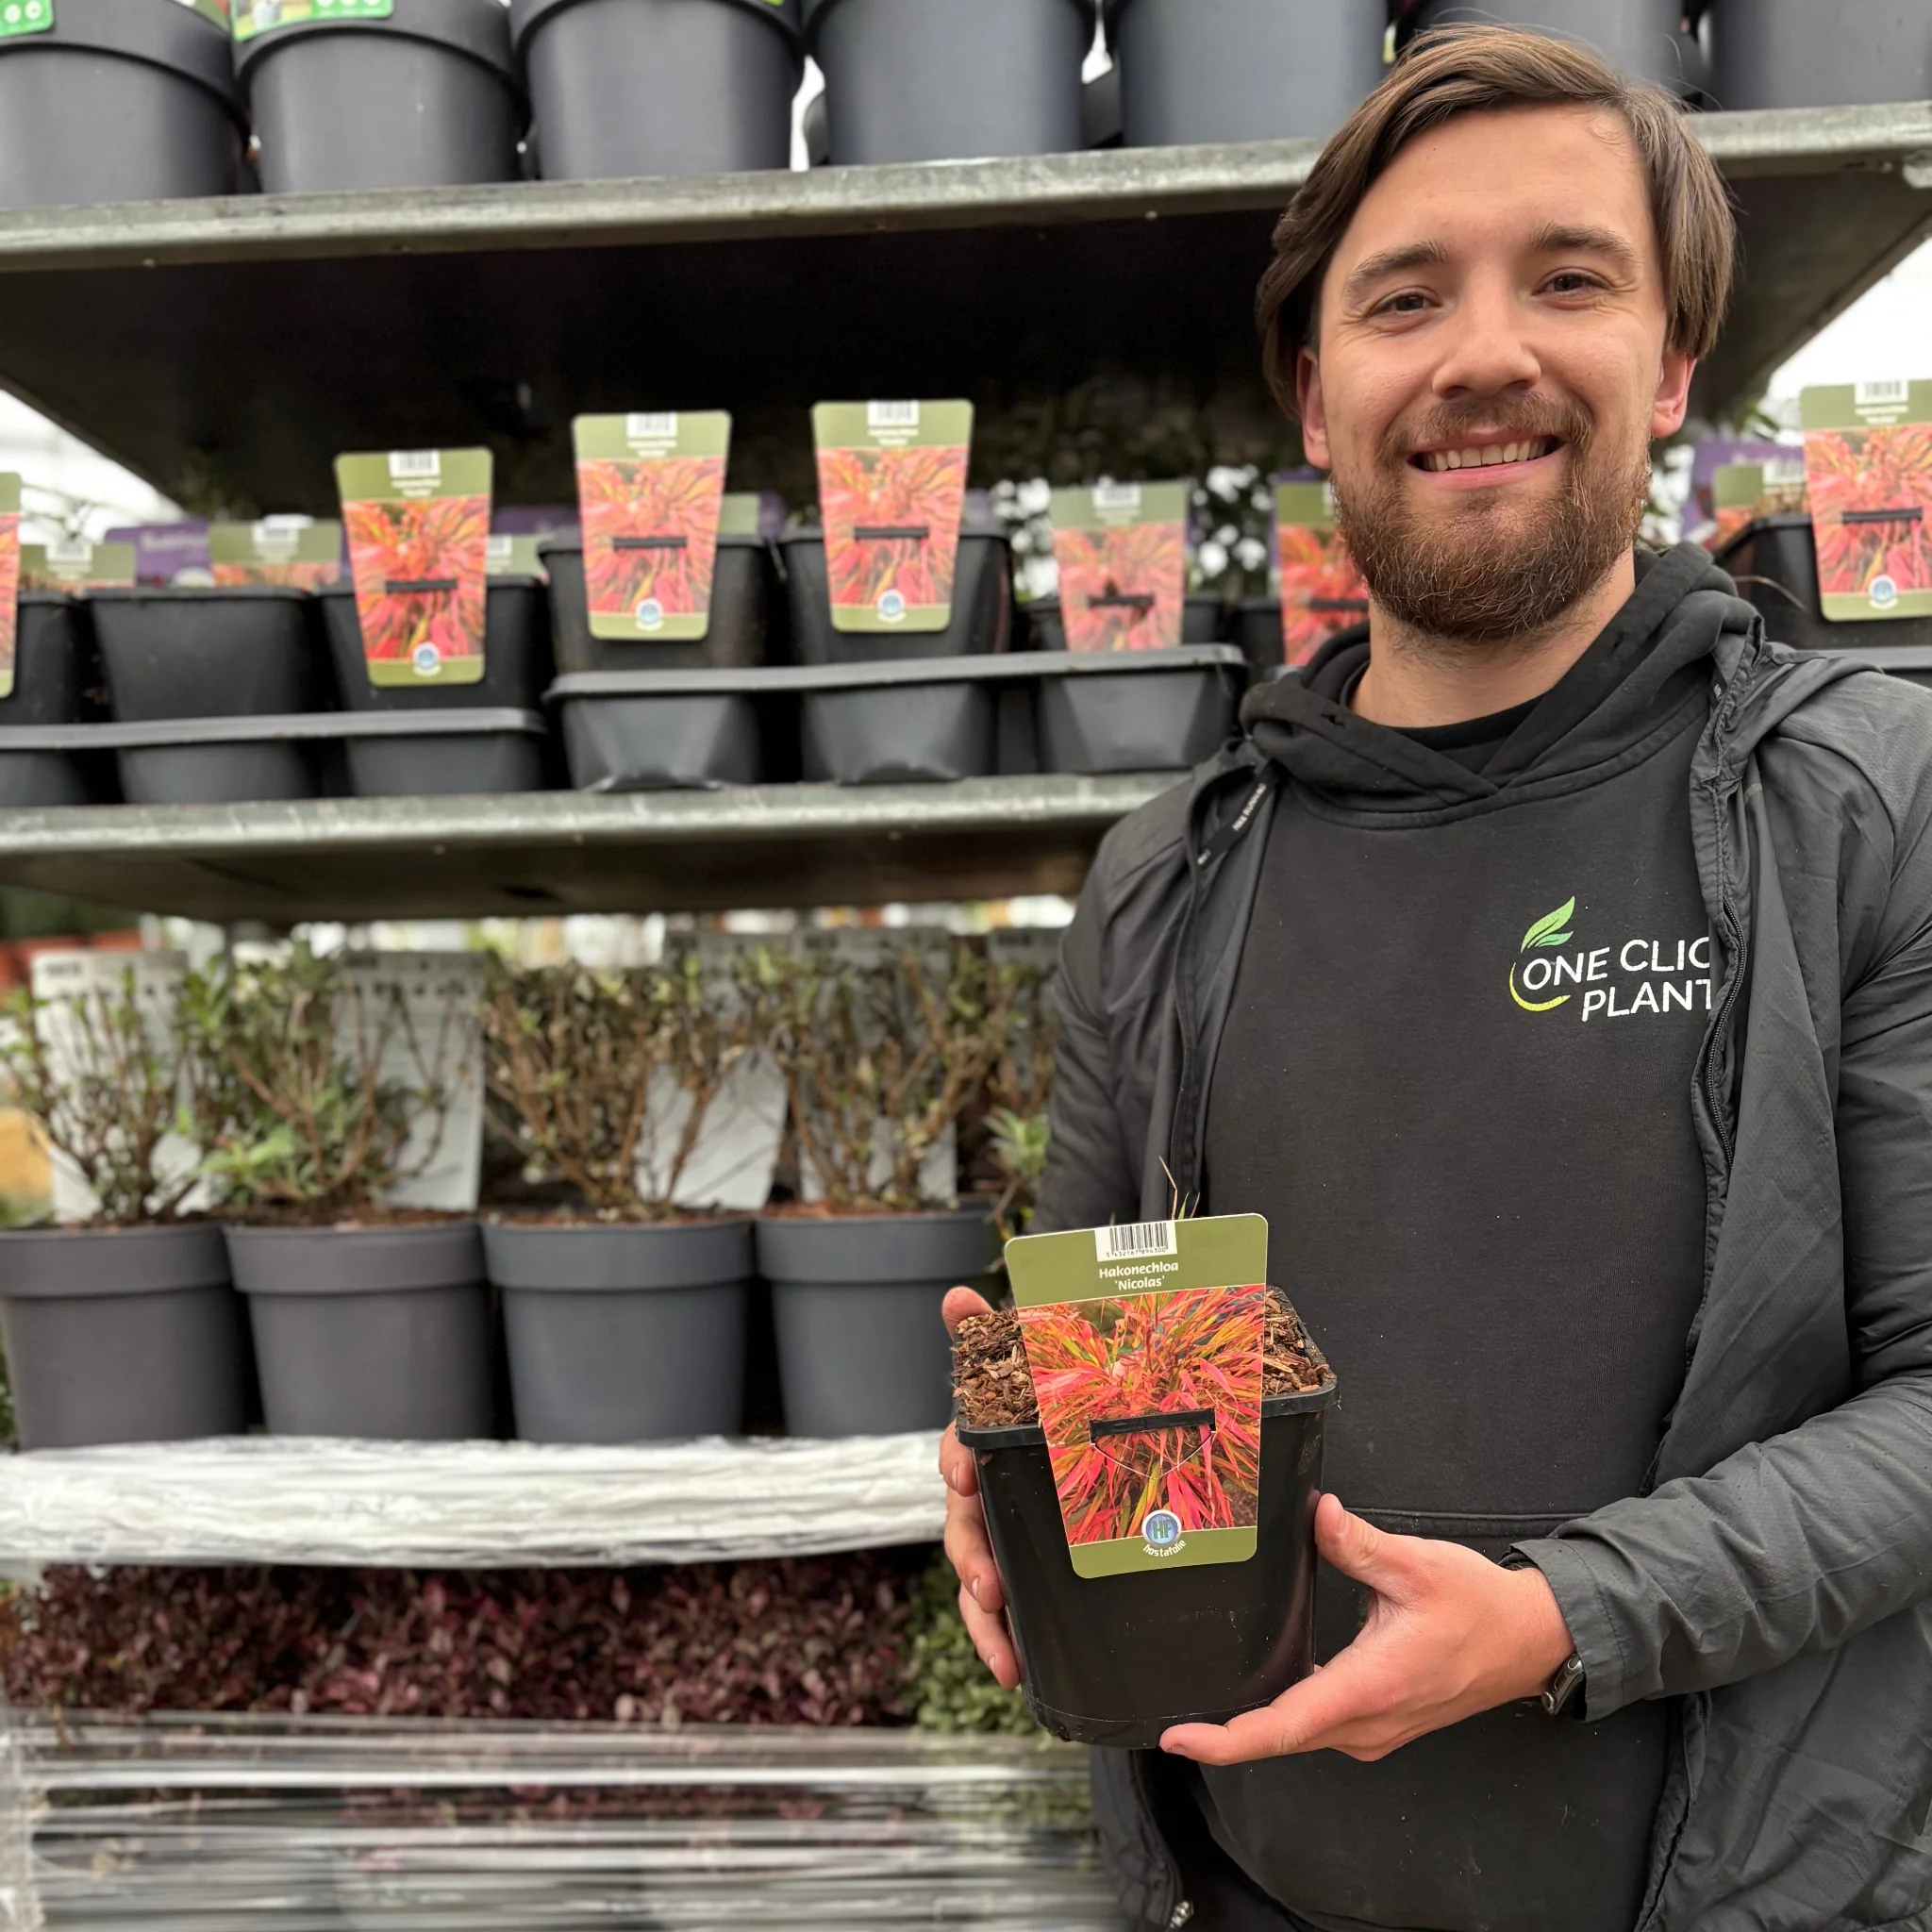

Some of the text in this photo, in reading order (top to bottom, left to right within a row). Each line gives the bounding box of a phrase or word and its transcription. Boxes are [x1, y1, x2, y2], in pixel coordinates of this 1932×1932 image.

[1523, 947, 1610, 991] ONE
[1582, 978, 1712, 1022] PLANT
[1099, 1261, 1178, 1278] Hakonechloa
[1152, 1519, 1173, 1540] HF
[1142, 1540, 1187, 1557] hostafolie
